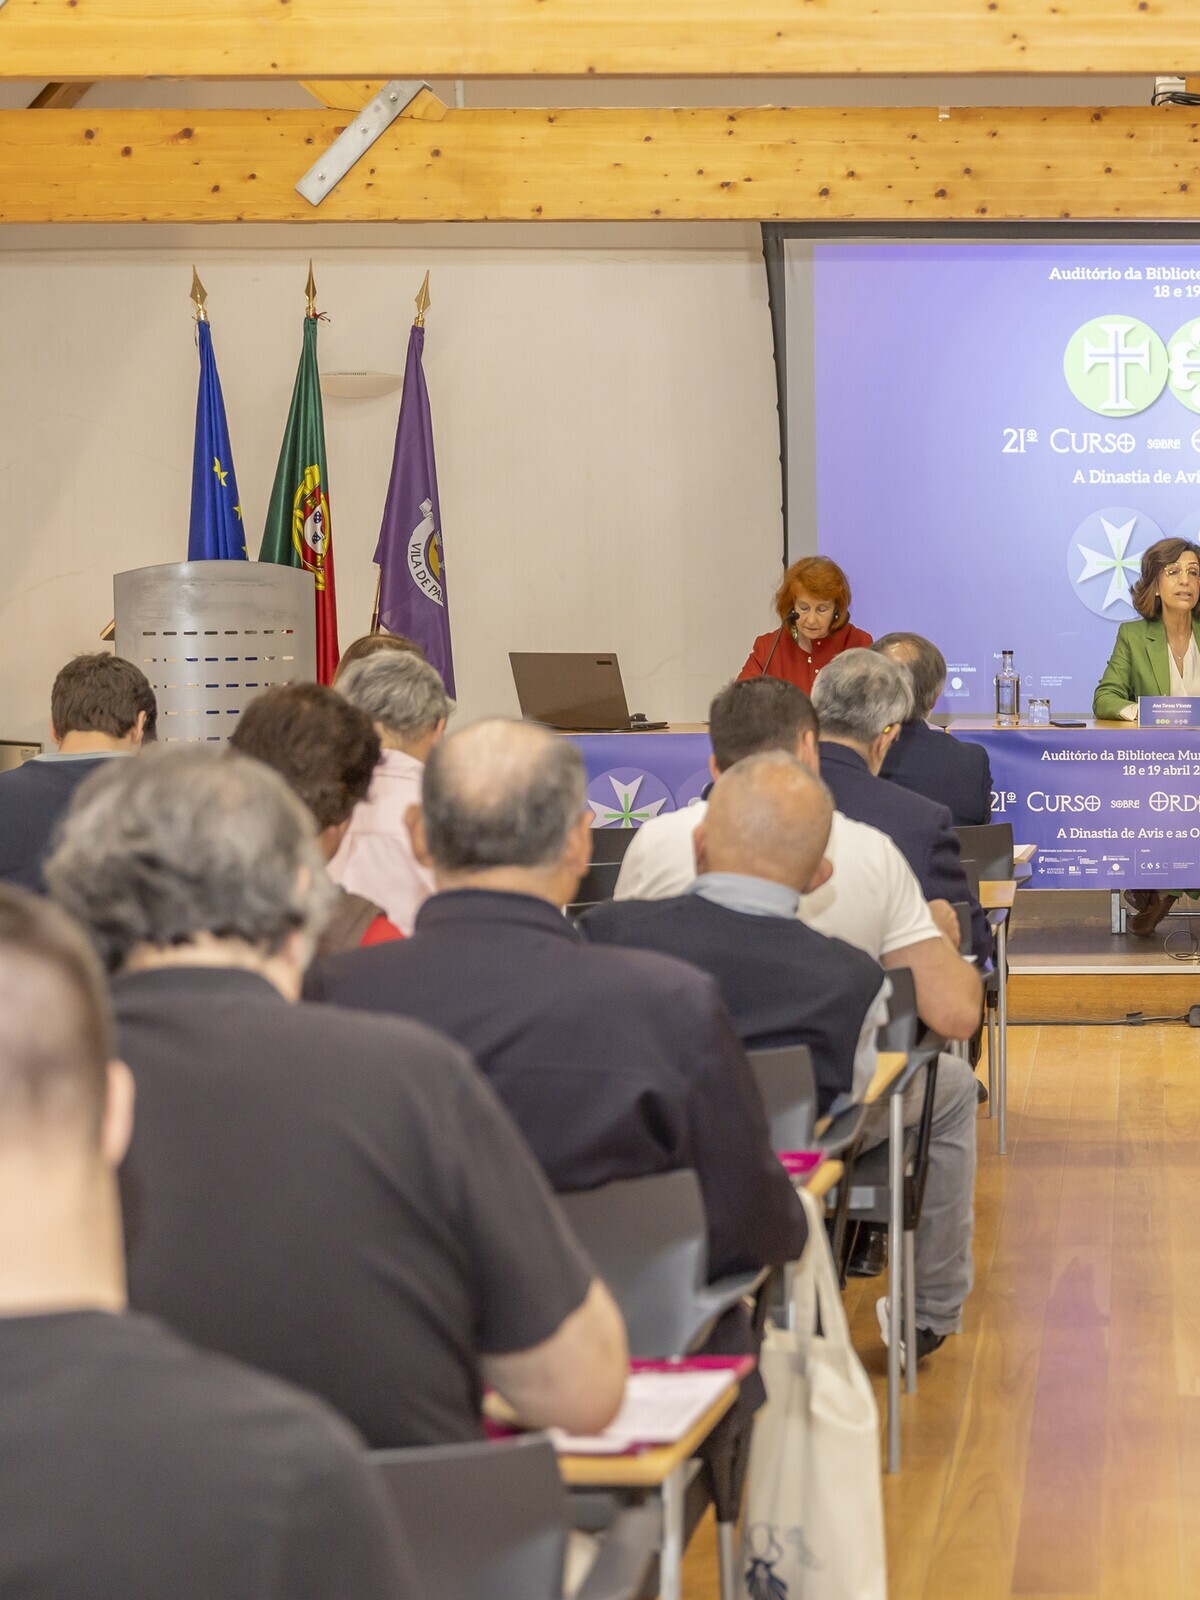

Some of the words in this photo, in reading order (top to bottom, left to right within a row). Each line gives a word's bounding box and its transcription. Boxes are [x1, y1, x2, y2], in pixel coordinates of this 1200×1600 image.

[1049, 267, 1121, 280] Auditório
[1124, 267, 1142, 280] da
[1153, 285, 1170, 298] 18
[1173, 288, 1182, 298] e
[1073, 470, 1086, 484] A
[1089, 470, 1150, 484] Dinastia
[1153, 470, 1171, 484] de
[411, 543, 422, 569] VILA
[416, 570, 431, 587] DE
[1041, 750, 1098, 761] Auditório
[1100, 750, 1114, 761] da
[1117, 750, 1175, 761] Biblioteca
[1123, 765, 1136, 776] 18
[1139, 768, 1146, 776] e
[1148, 765, 1160, 776] 19
[1163, 765, 1190, 776] abril
[1057, 828, 1067, 839] A
[1070, 828, 1118, 839] Dinastia
[1121, 828, 1135, 839] de
[1138, 828, 1164, 839] Avis
[1166, 831, 1173, 839] e
[1176, 831, 1187, 839] as
